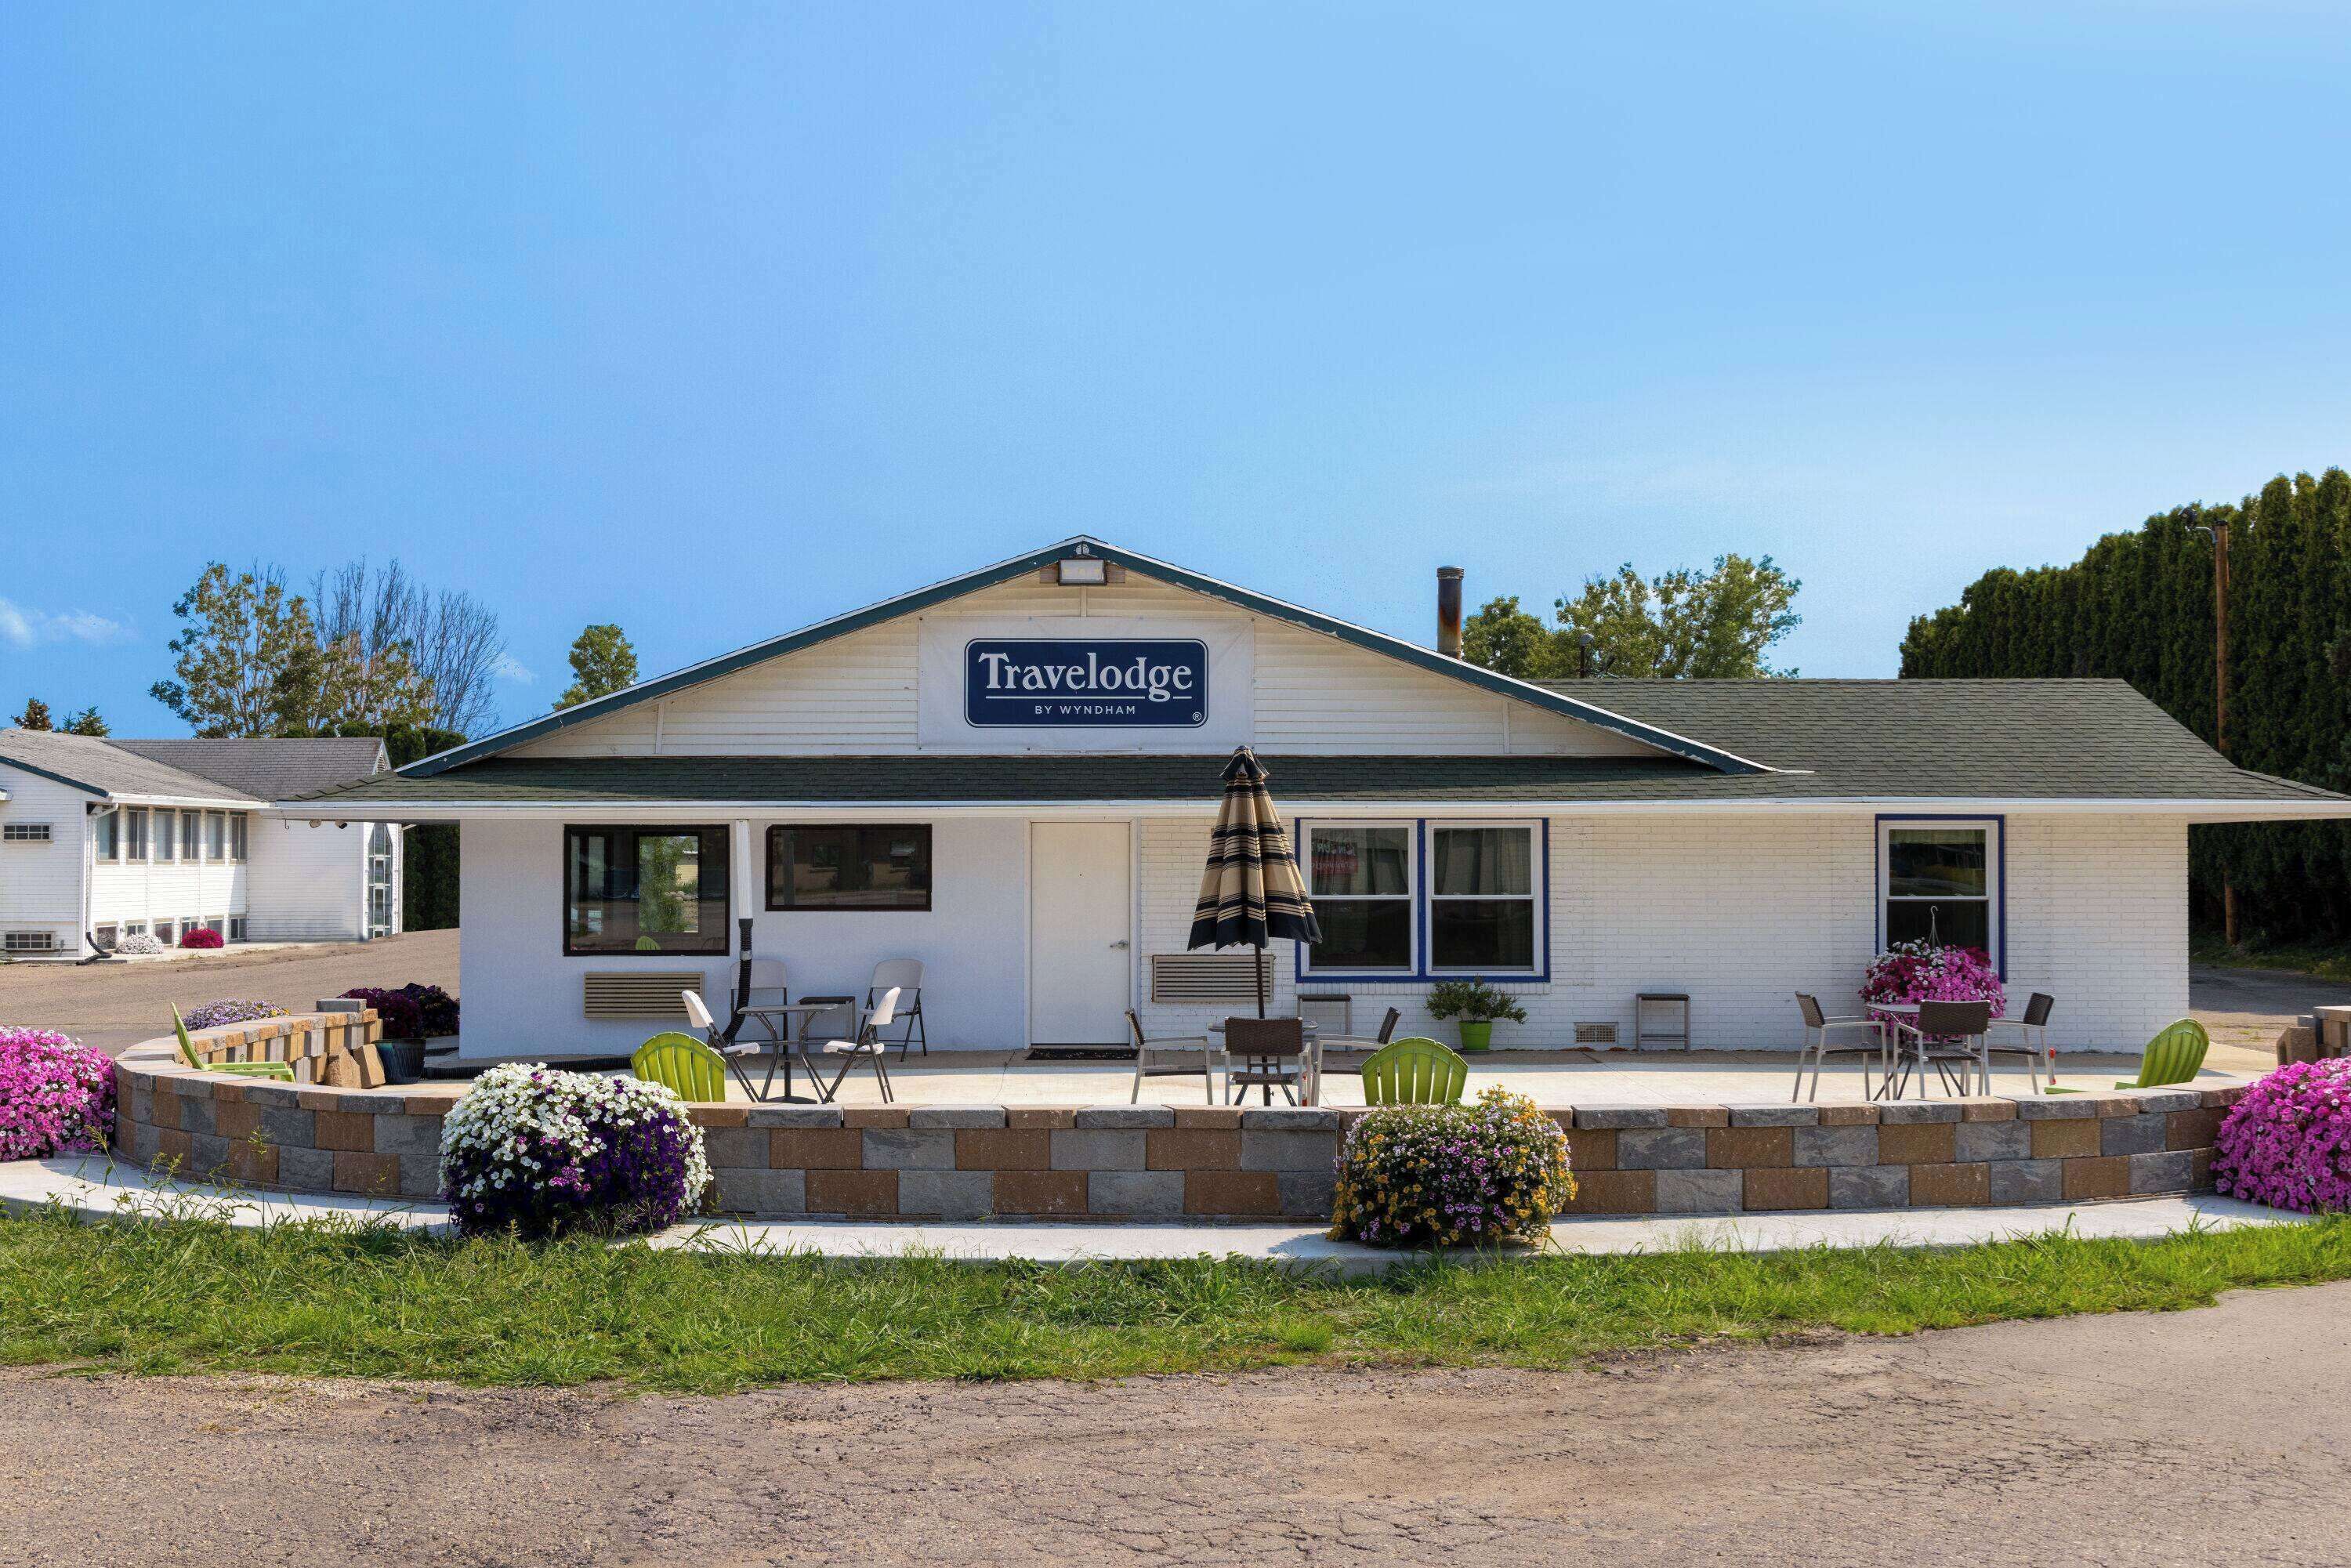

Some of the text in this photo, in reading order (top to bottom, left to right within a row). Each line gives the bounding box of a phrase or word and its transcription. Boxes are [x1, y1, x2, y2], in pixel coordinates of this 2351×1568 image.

[978, 652, 1193, 702] Travelodge
[1034, 705, 1136, 715] BY WYNDHAM
